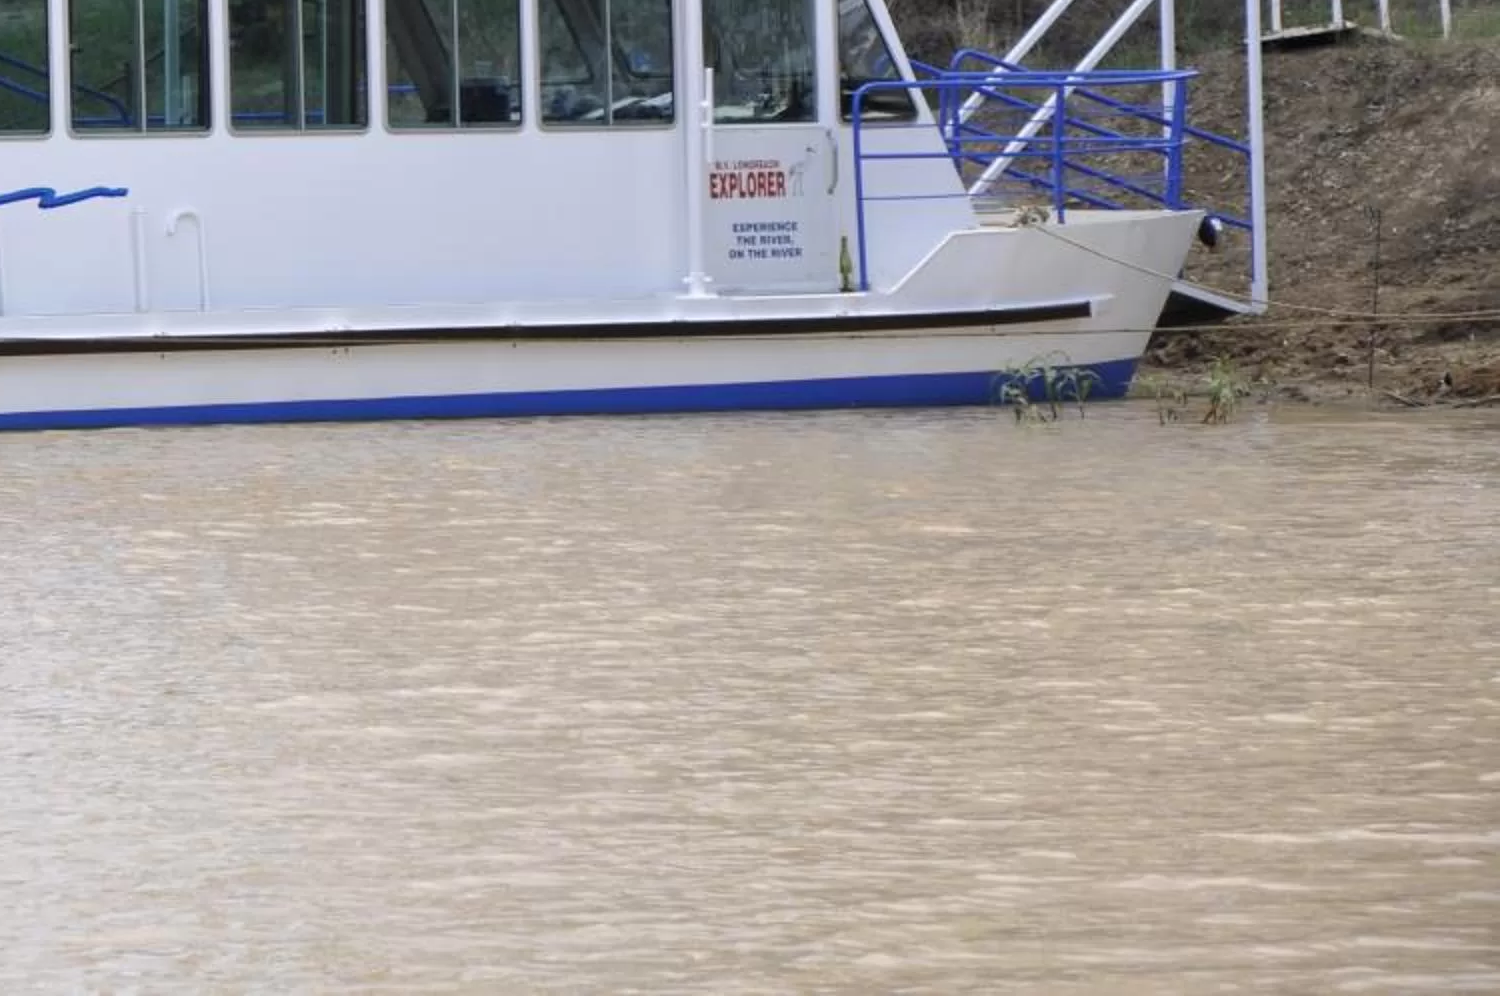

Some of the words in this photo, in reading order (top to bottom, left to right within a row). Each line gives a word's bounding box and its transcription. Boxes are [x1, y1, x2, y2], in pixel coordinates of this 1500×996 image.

[709, 171, 786, 199] EXPLORER
[732, 221, 798, 233] EXPERIENCE
[736, 235, 756, 245] THE
[728, 248, 744, 259] ON
[747, 247, 767, 259] THE
[771, 247, 803, 258] RIVER
